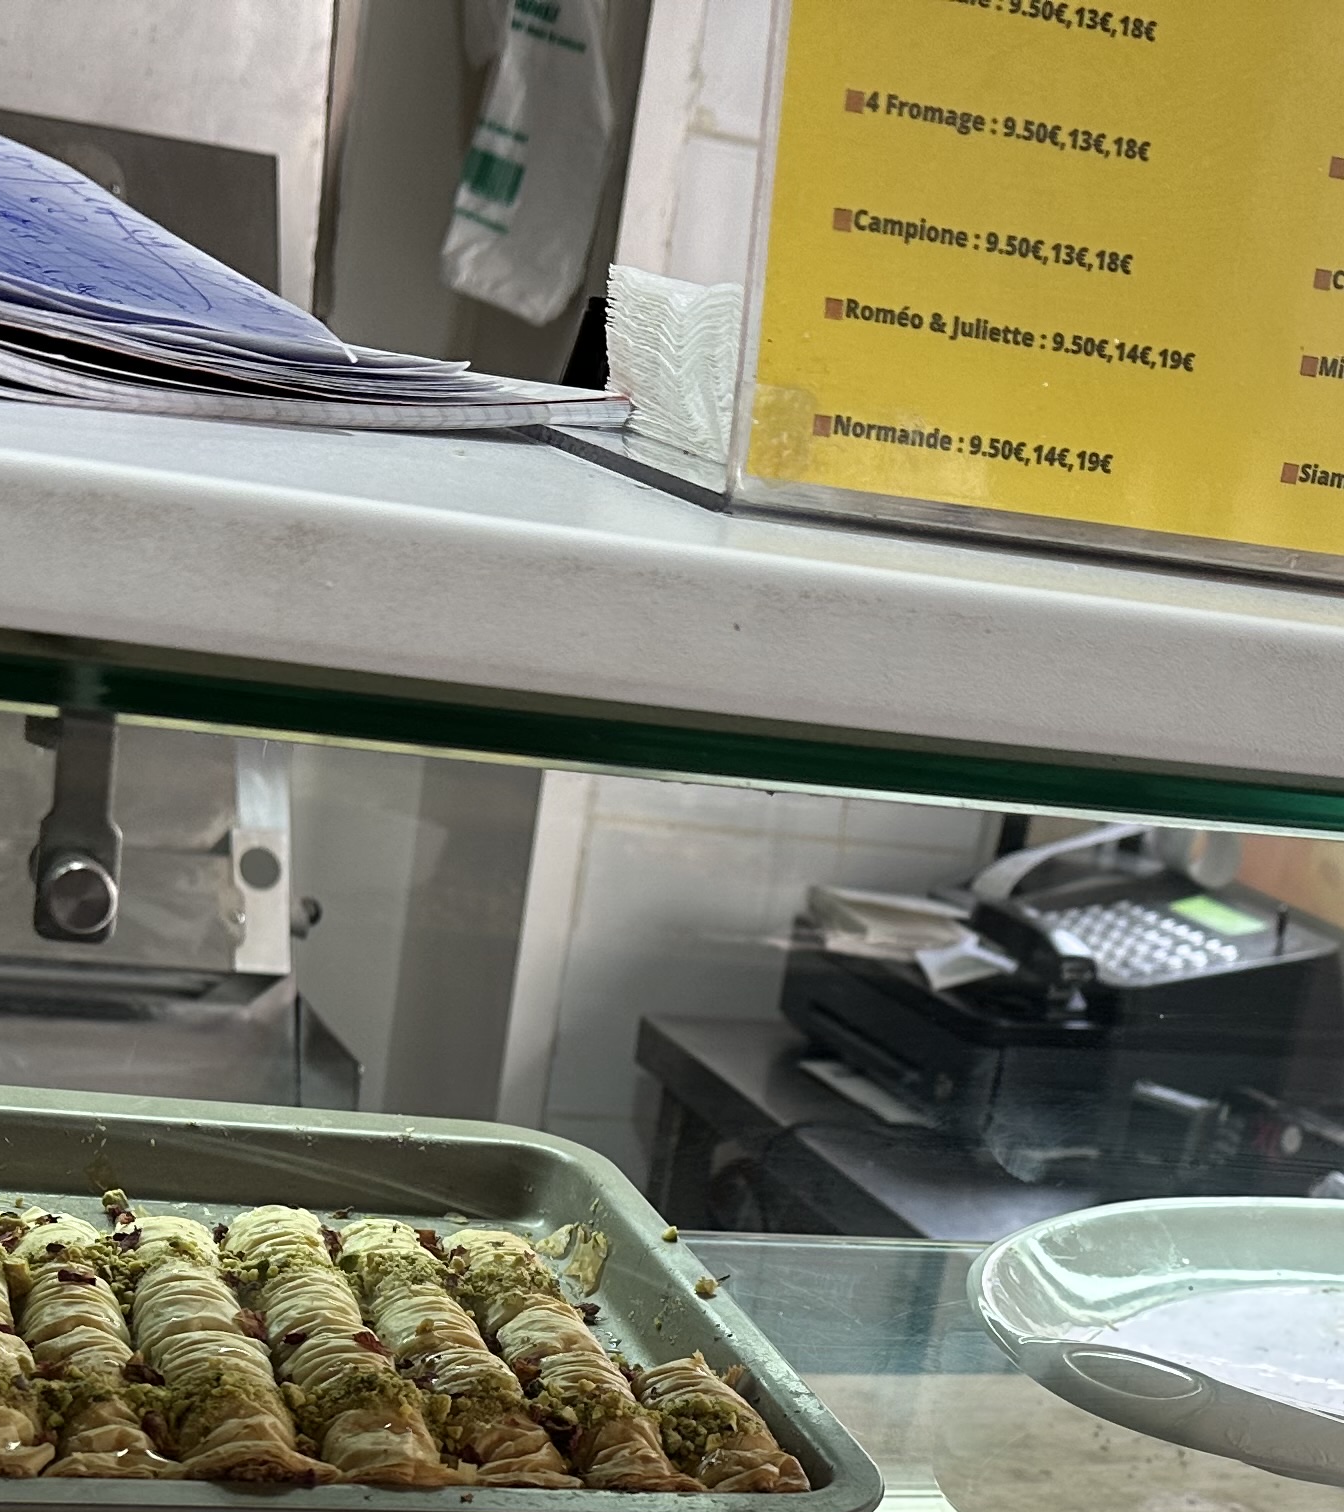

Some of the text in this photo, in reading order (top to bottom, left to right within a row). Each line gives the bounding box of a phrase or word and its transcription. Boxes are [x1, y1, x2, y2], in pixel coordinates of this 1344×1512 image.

[865, 92, 880, 111] 4
[886, 94, 986, 134] Fromage
[1004, 117, 1150, 161] 9.50€,13€,18€
[854, 209, 968, 247] Campione
[986, 232, 1133, 274] 9.50€,13€,18€
[846, 299, 923, 328] Roméo
[929, 313, 946, 332] &
[949, 316, 1034, 346] Juliette
[1052, 333, 1196, 371] 9.50€,14€,19€
[833, 415, 952, 450] Normande
[970, 436, 1113, 473] 9.50€,14€,19€
